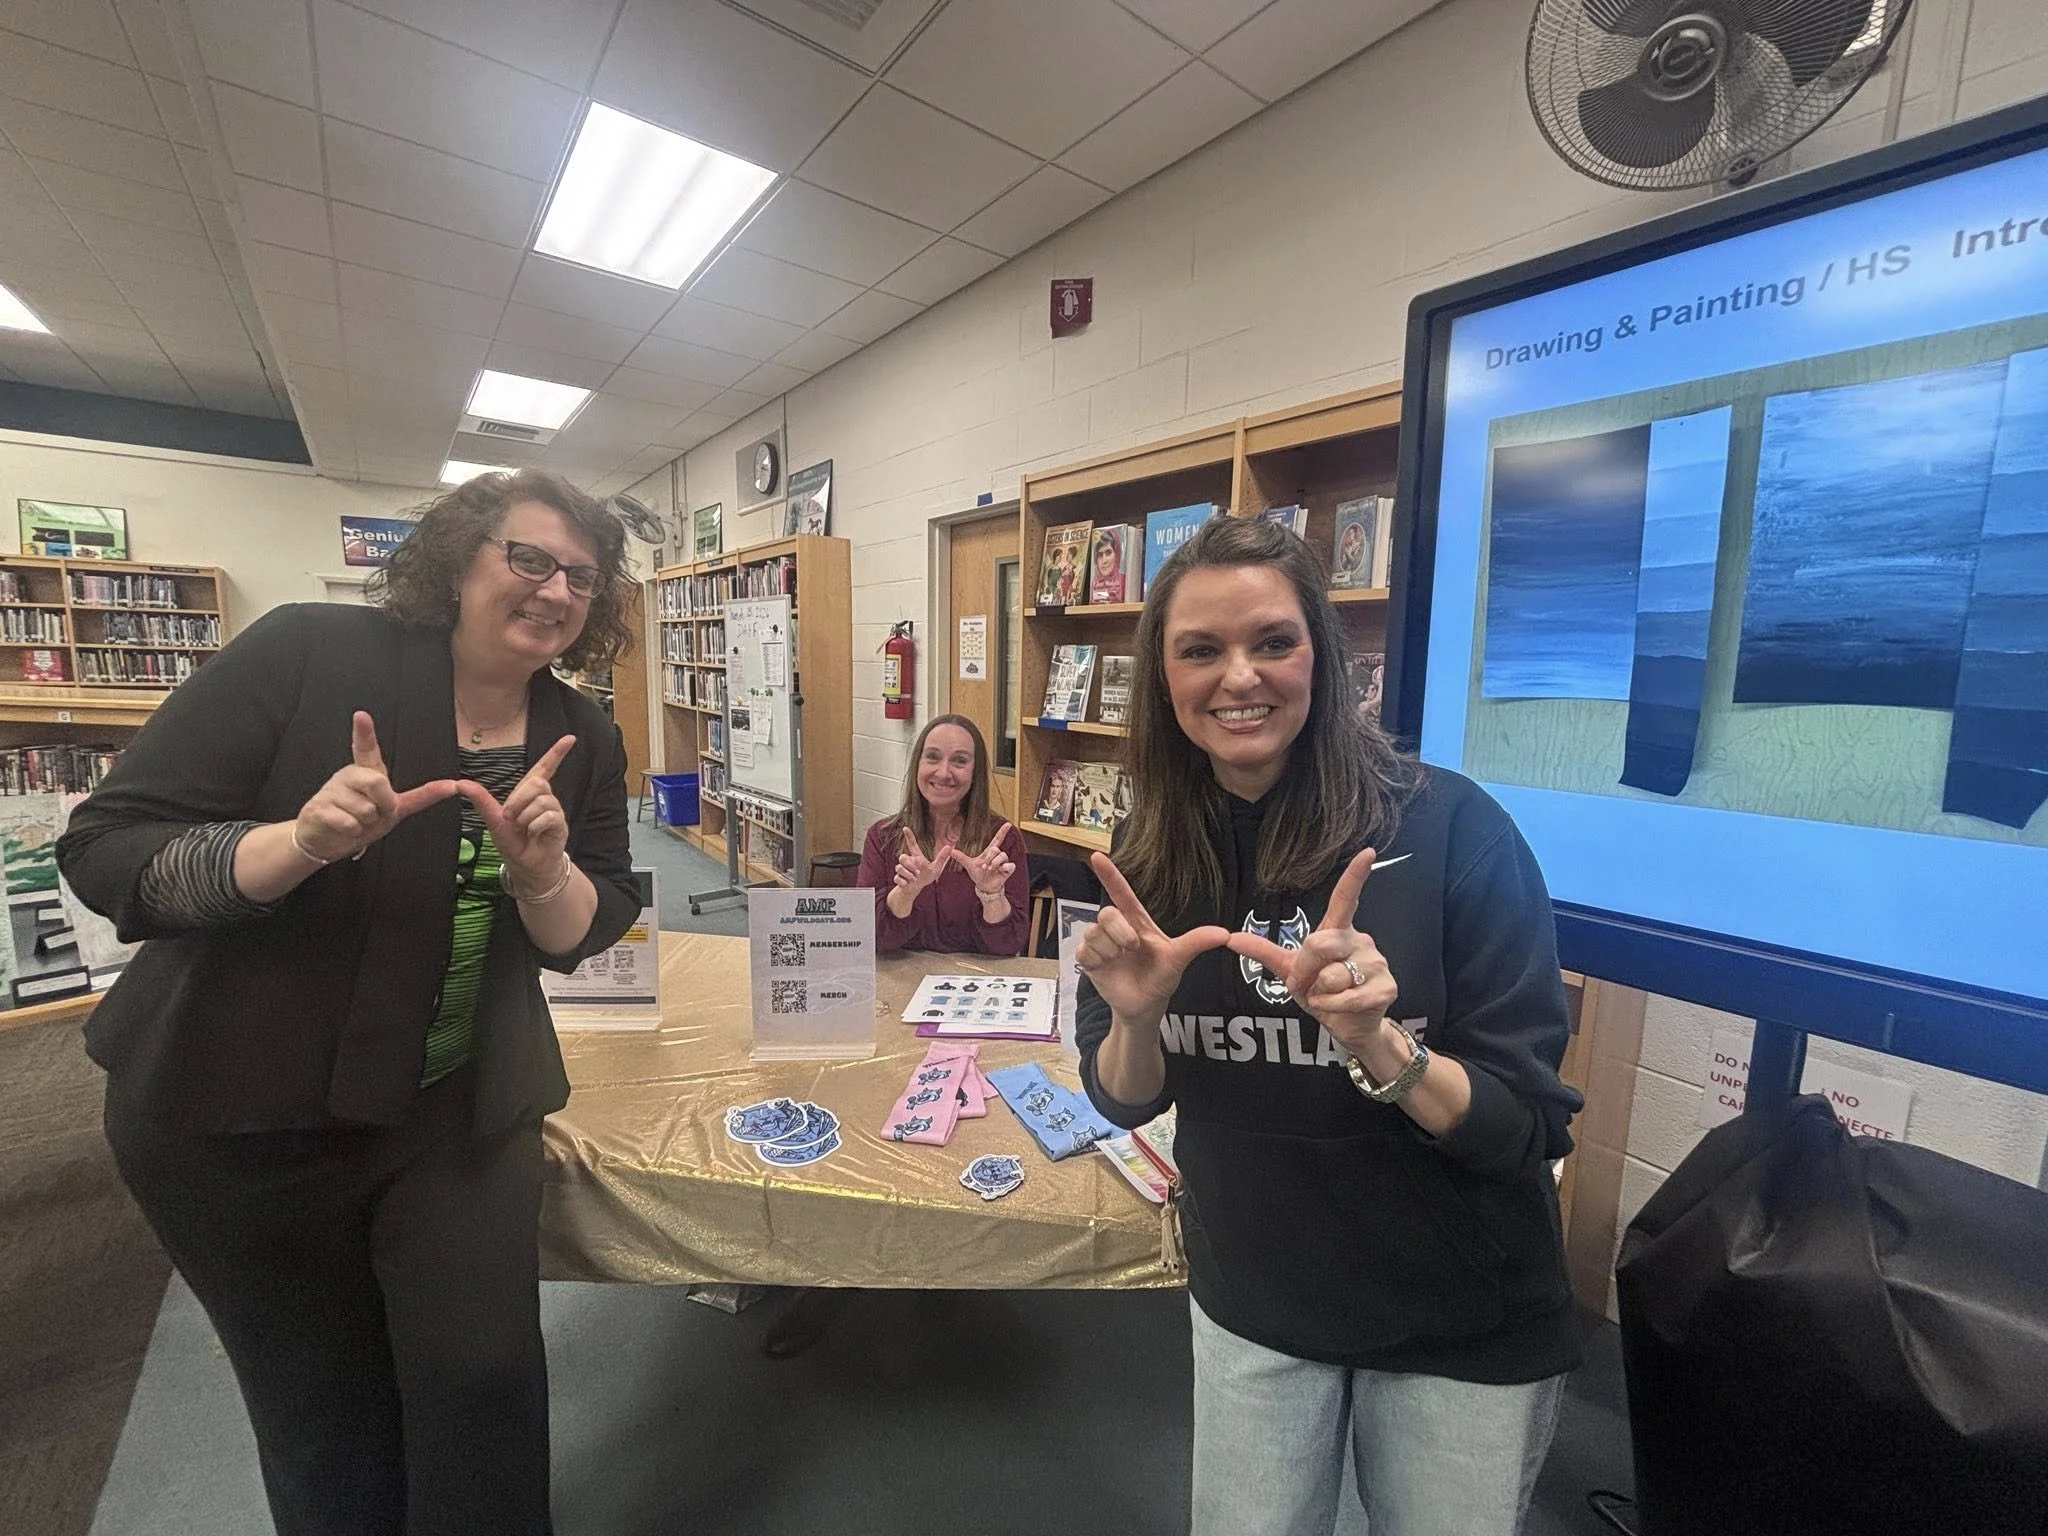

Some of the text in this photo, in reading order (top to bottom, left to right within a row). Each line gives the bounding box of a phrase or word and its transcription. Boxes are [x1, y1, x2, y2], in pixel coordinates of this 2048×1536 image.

[1485, 325, 1604, 372] Drawing
[1614, 313, 1637, 340] &
[1650, 275, 1806, 333] Painting
[1818, 262, 1835, 292] /
[1847, 244, 1912, 286] HS
[350, 527, 404, 543] Geniu
[1155, 523, 1200, 546] WOMEN
[366, 545, 391, 558] Ba
[795, 898, 837, 916] AMP
[1074, 963, 1082, 975] S
[820, 991, 847, 999] MERCH
[1159, 1013, 1428, 1067] WESTLAE
[1714, 1052, 1738, 1068] DO
[1832, 1091, 1860, 1108] NO
